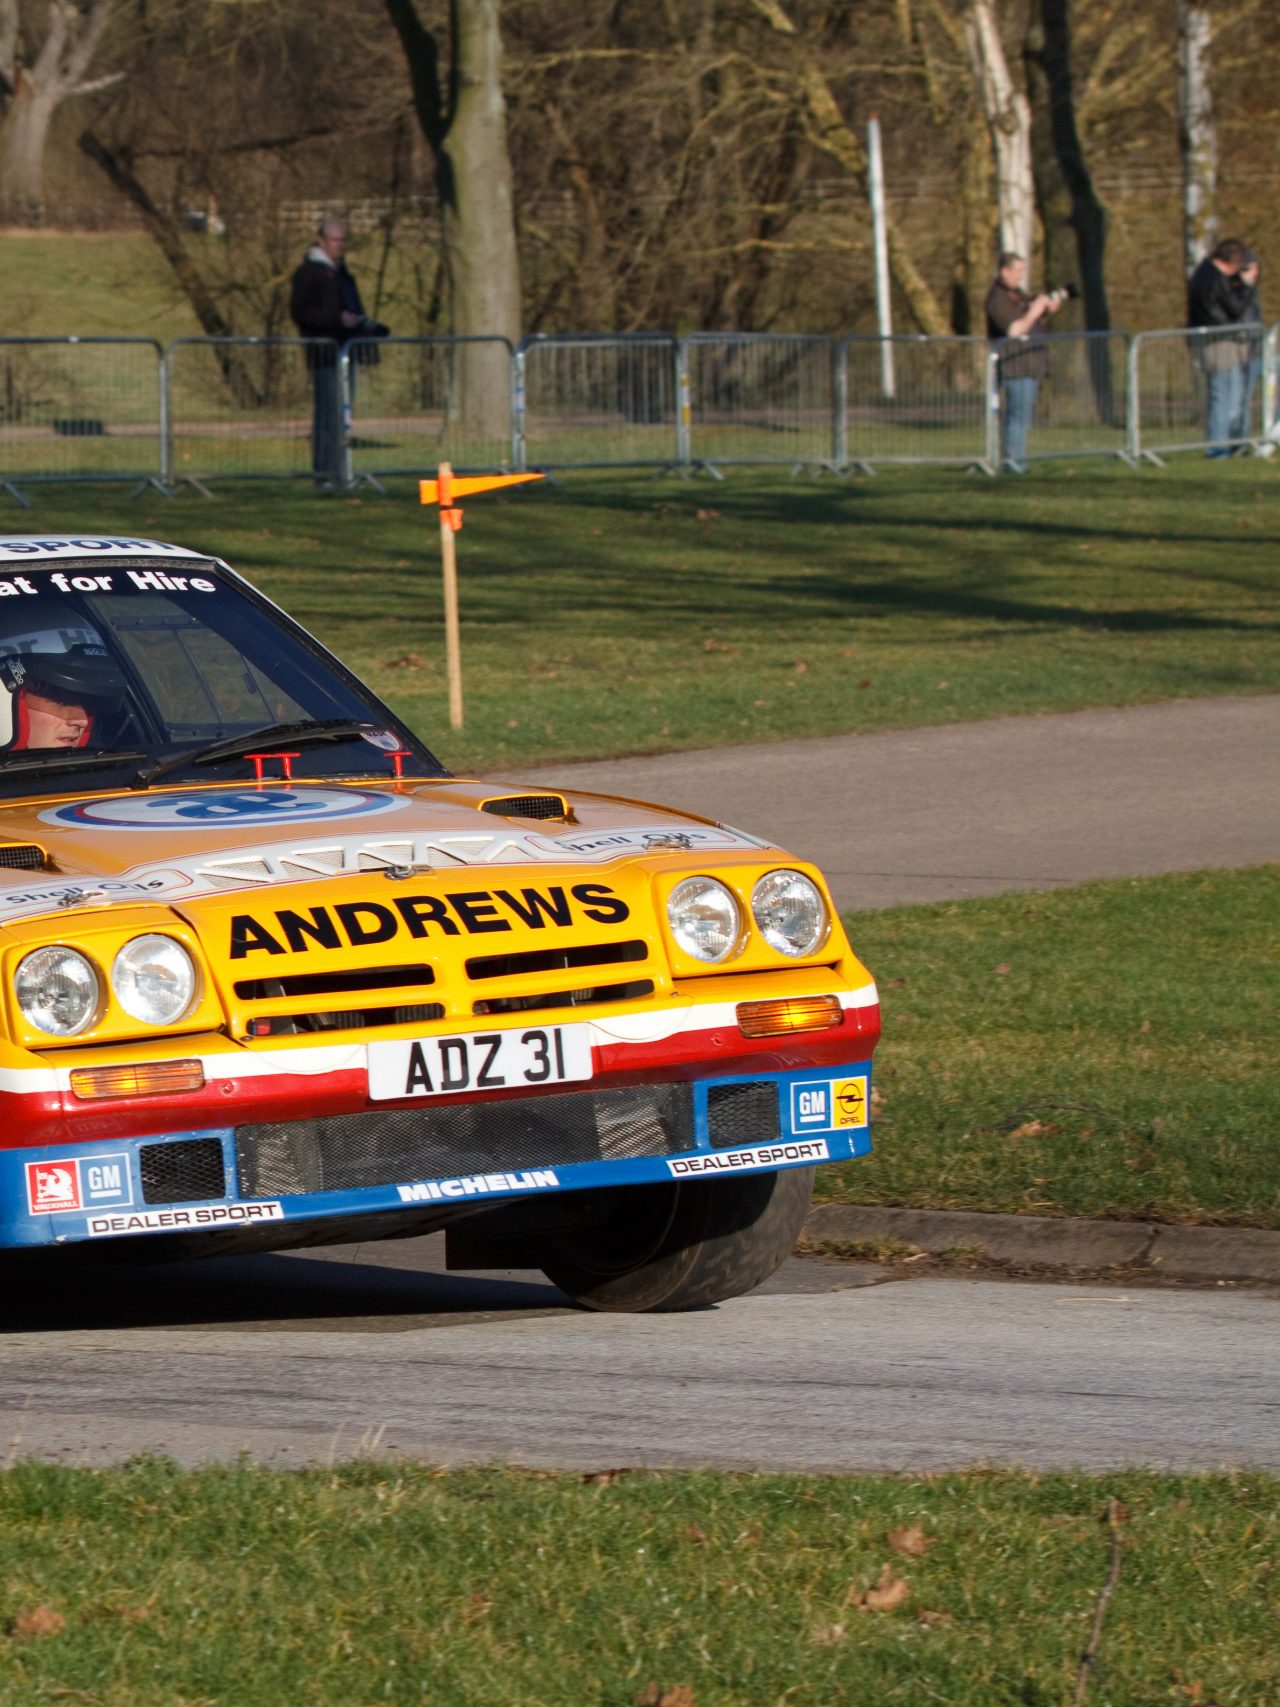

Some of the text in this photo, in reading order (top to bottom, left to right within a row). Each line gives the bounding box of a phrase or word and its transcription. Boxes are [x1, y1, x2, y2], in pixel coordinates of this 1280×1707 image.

[50, 572, 114, 593] for
[126, 570, 217, 593] Hire
[5, 879, 164, 904] Shell Oils
[229, 883, 631, 960] ANDREWS
[405, 1027, 565, 1095] ADZ 31
[799, 1090, 826, 1115] GM
[839, 1116, 862, 1125] OPEL
[672, 1142, 823, 1174] DEALER SPORT
[87, 1164, 121, 1191] GM
[396, 1170, 560, 1203] MICHELIN
[33, 1200, 79, 1212] VAUXHALL
[91, 1204, 278, 1234] DEALER SPORT
